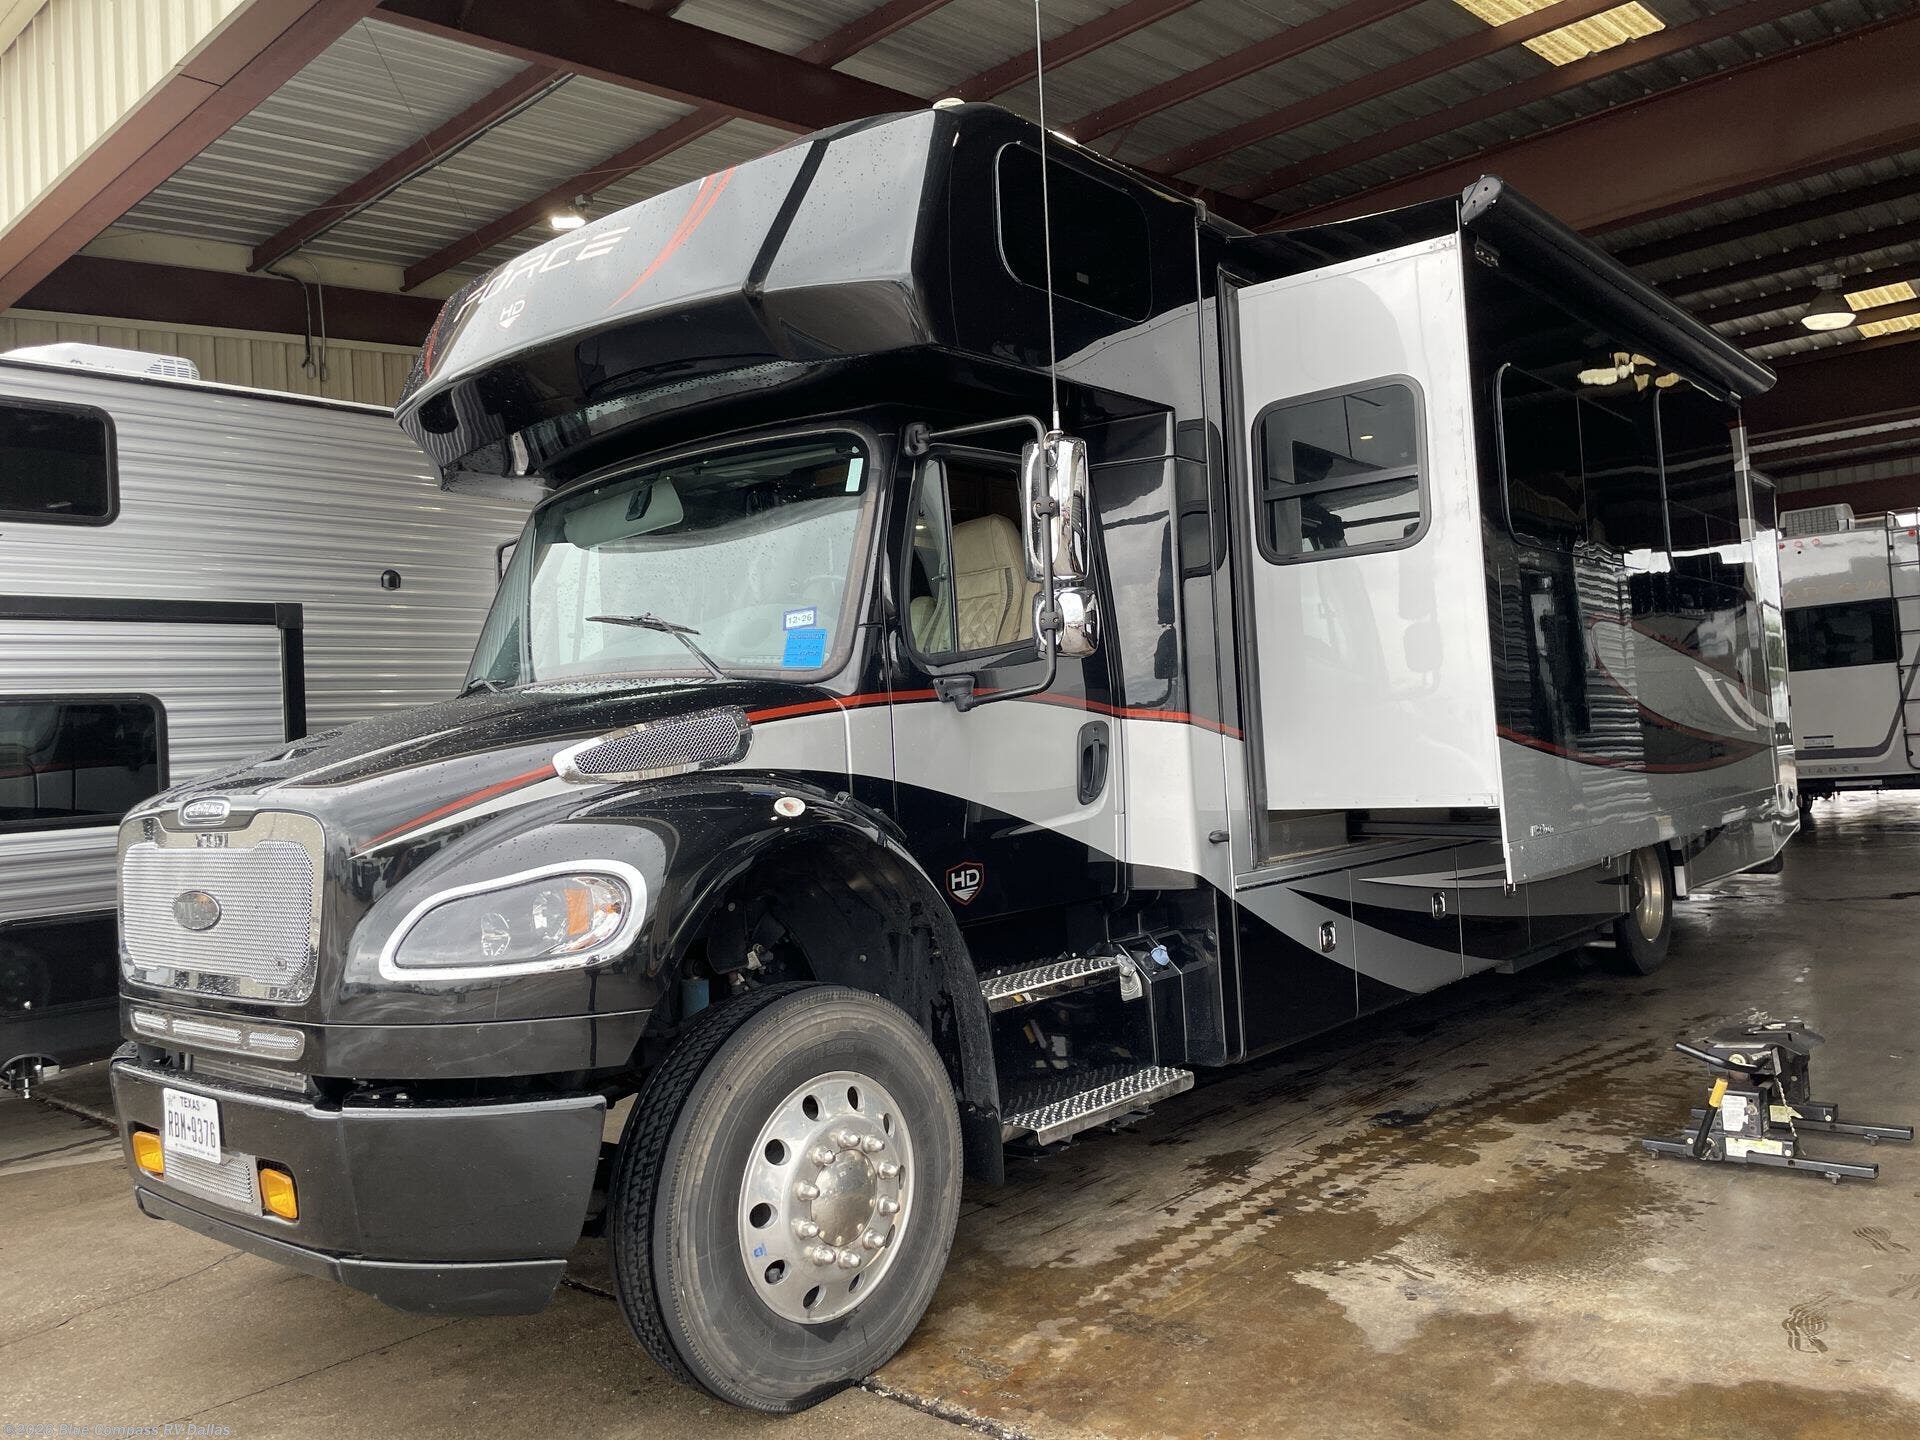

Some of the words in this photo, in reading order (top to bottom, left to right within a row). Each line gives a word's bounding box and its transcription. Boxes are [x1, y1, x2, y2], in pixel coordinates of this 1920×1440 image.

[453, 227, 631, 322] FORCE
[500, 300, 526, 321] HD
[951, 868, 980, 890] HD
[180, 1096, 200, 1111] TEXAS
